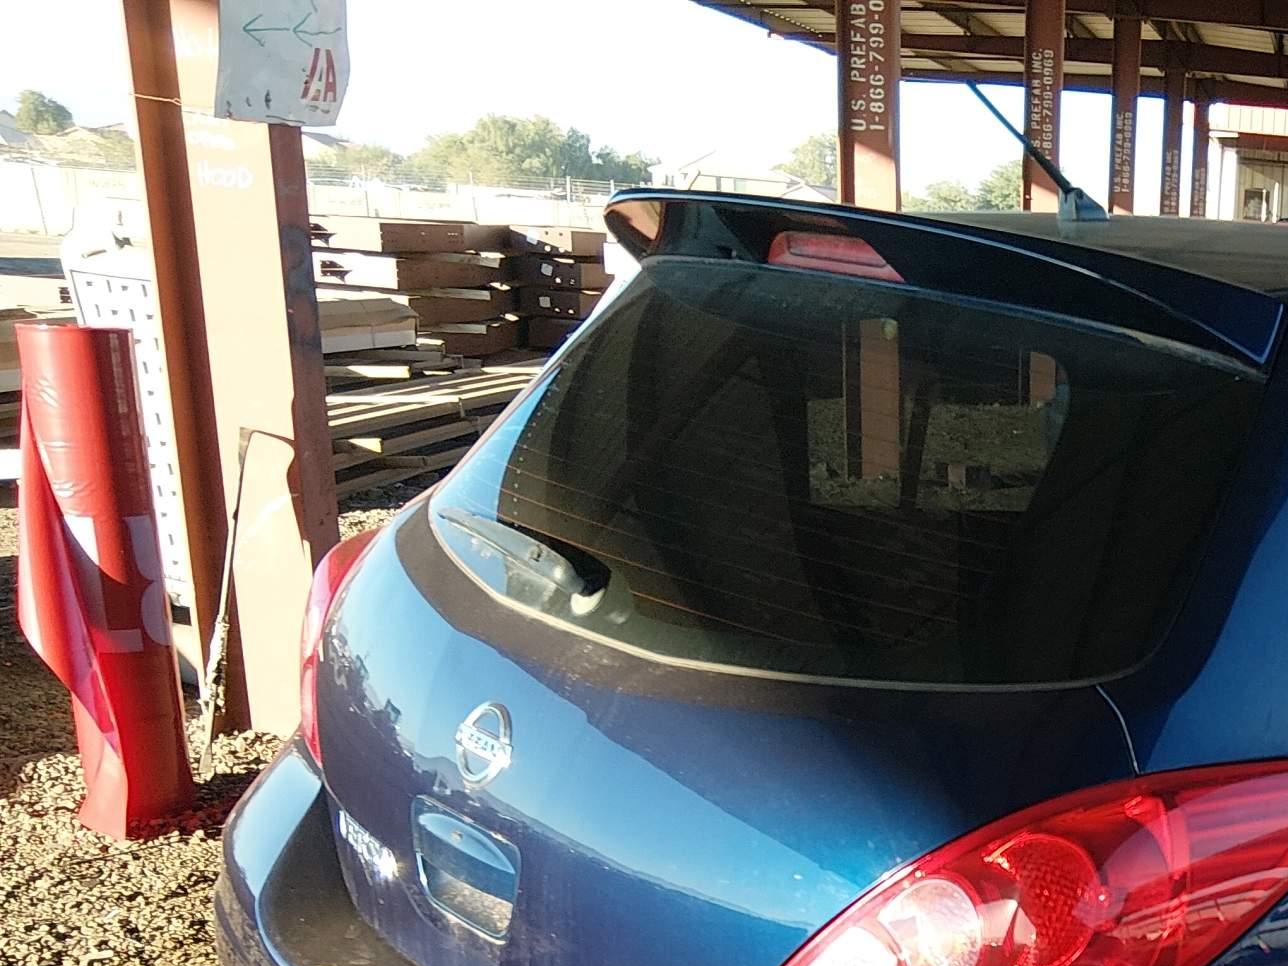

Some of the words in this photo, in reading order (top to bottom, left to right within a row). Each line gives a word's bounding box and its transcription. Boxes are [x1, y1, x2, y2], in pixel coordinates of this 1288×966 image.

[850, 3, 867, 82] PREFAB
[1031, 48, 1043, 74] INC.
[850, 94, 867, 131] U.S.
